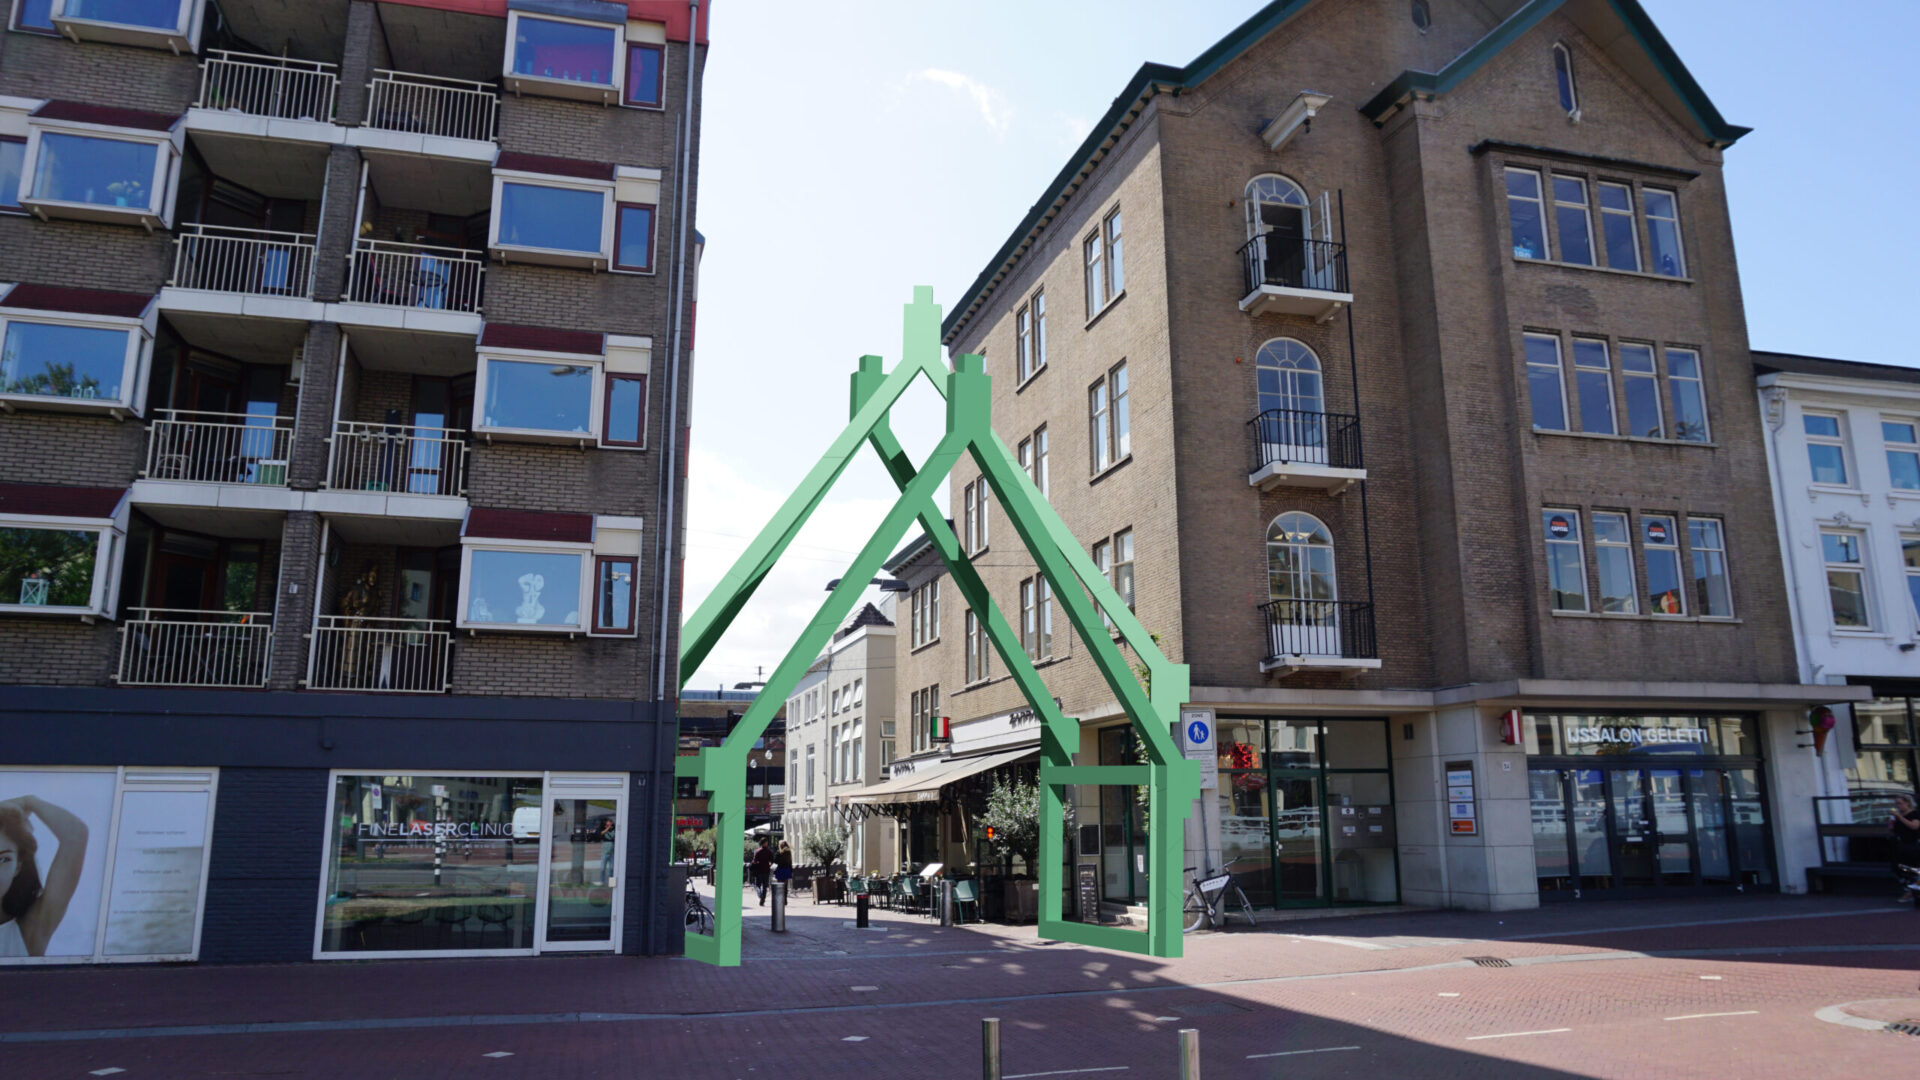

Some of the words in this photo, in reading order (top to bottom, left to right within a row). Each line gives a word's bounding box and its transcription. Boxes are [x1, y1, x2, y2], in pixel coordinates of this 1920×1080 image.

[1567, 727, 1642, 743] IJSSALON
[1646, 728, 1709, 743] GELETTI
[358, 822, 513, 836] FINELASERCLINIC
